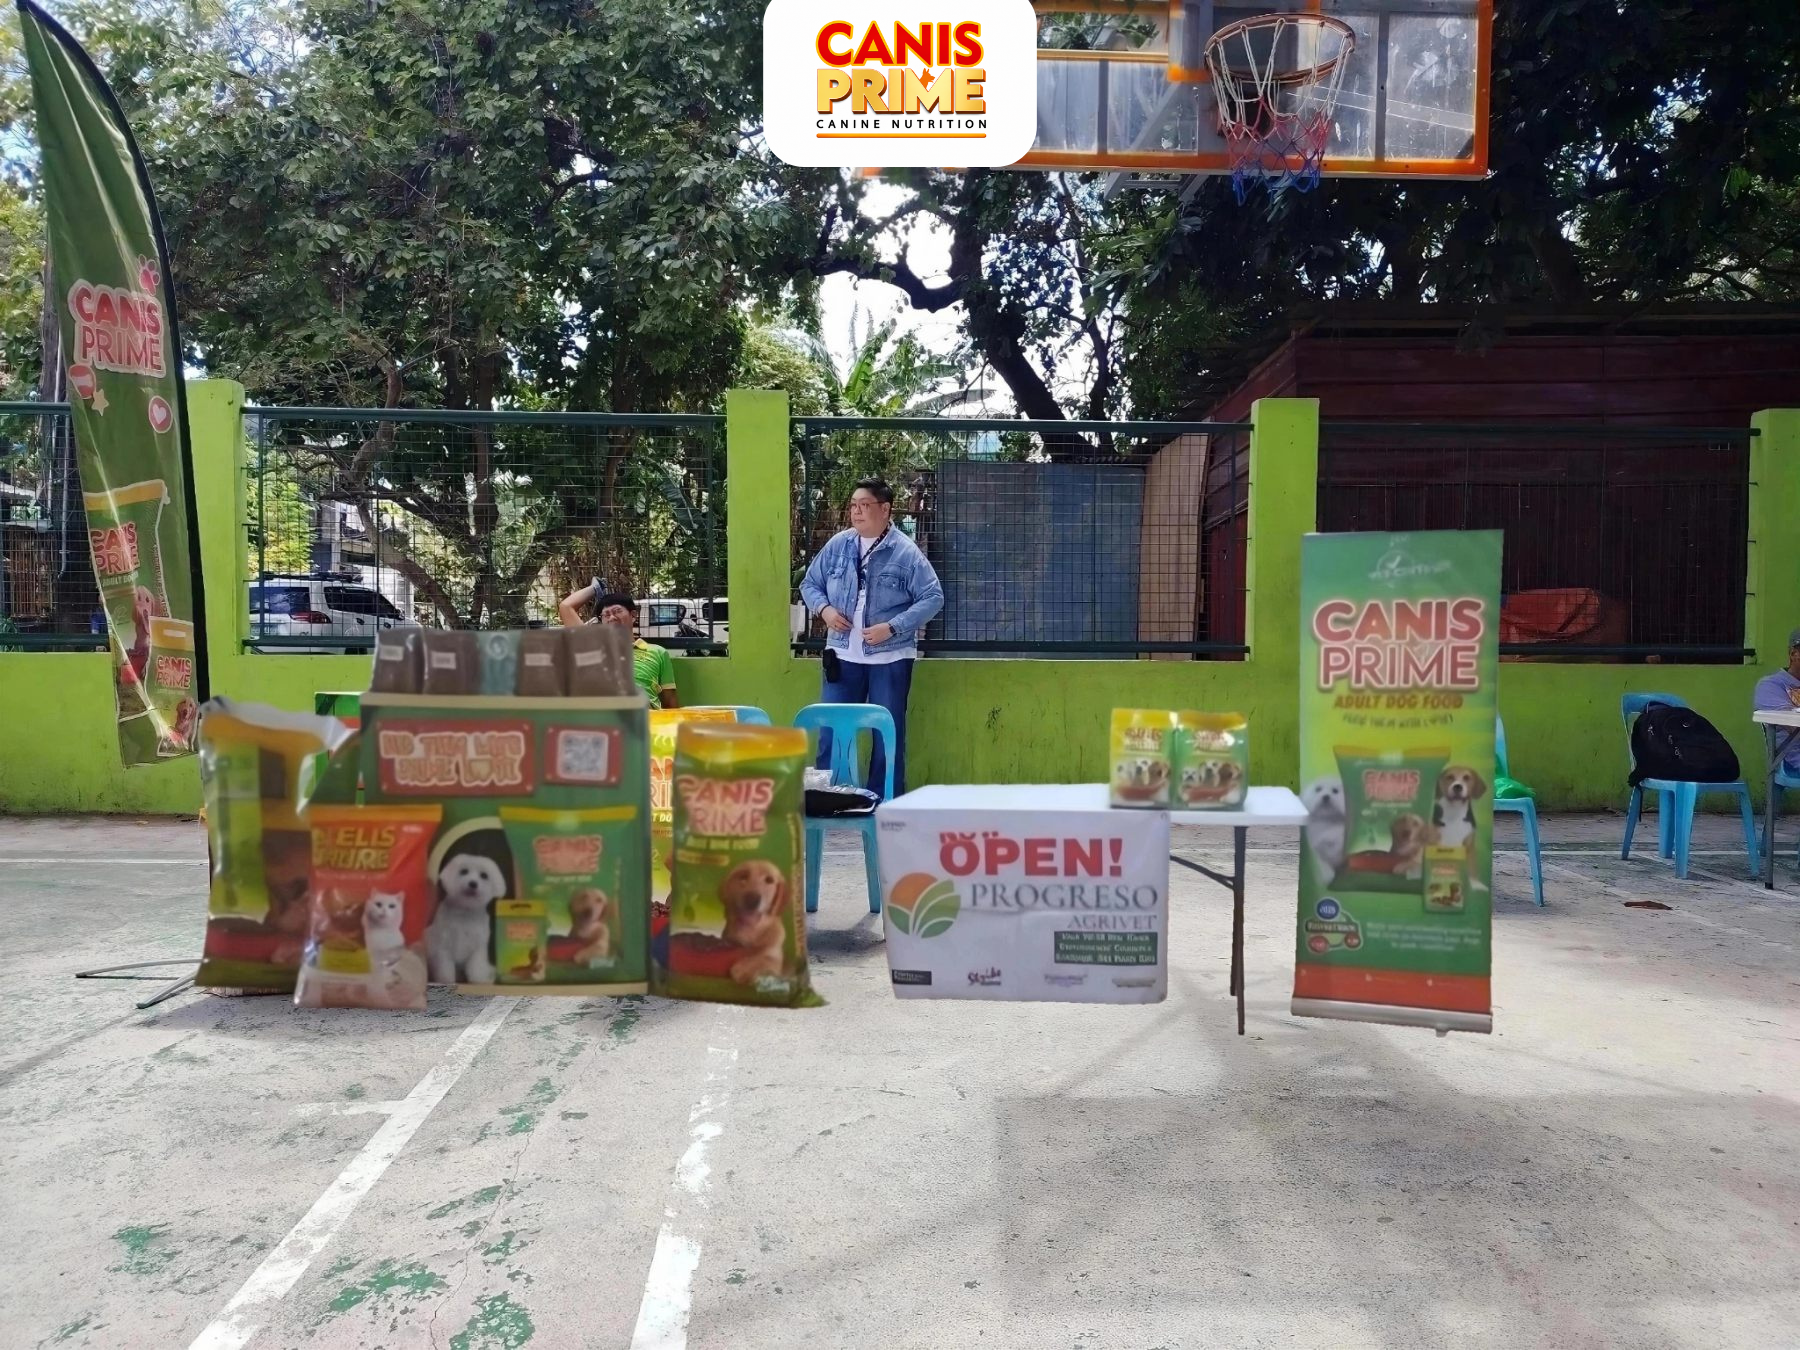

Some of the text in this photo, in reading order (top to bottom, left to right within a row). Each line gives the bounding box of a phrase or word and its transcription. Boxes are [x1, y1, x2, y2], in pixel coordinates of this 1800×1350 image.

[75, 287, 160, 335] CANIS
[82, 325, 162, 371] PRIME
[1315, 600, 1483, 642] CANIS
[157, 656, 191, 673] CANIS
[1321, 644, 1478, 686] PRIME
[156, 671, 190, 688] PRIME
[1334, 694, 1464, 709] ADULT DOG FOOD
[677, 778, 772, 804] CANIS
[939, 838, 1123, 877] OPEN!
[971, 883, 1158, 909] PROGRESO
[1067, 914, 1157, 930] AGRIVET
